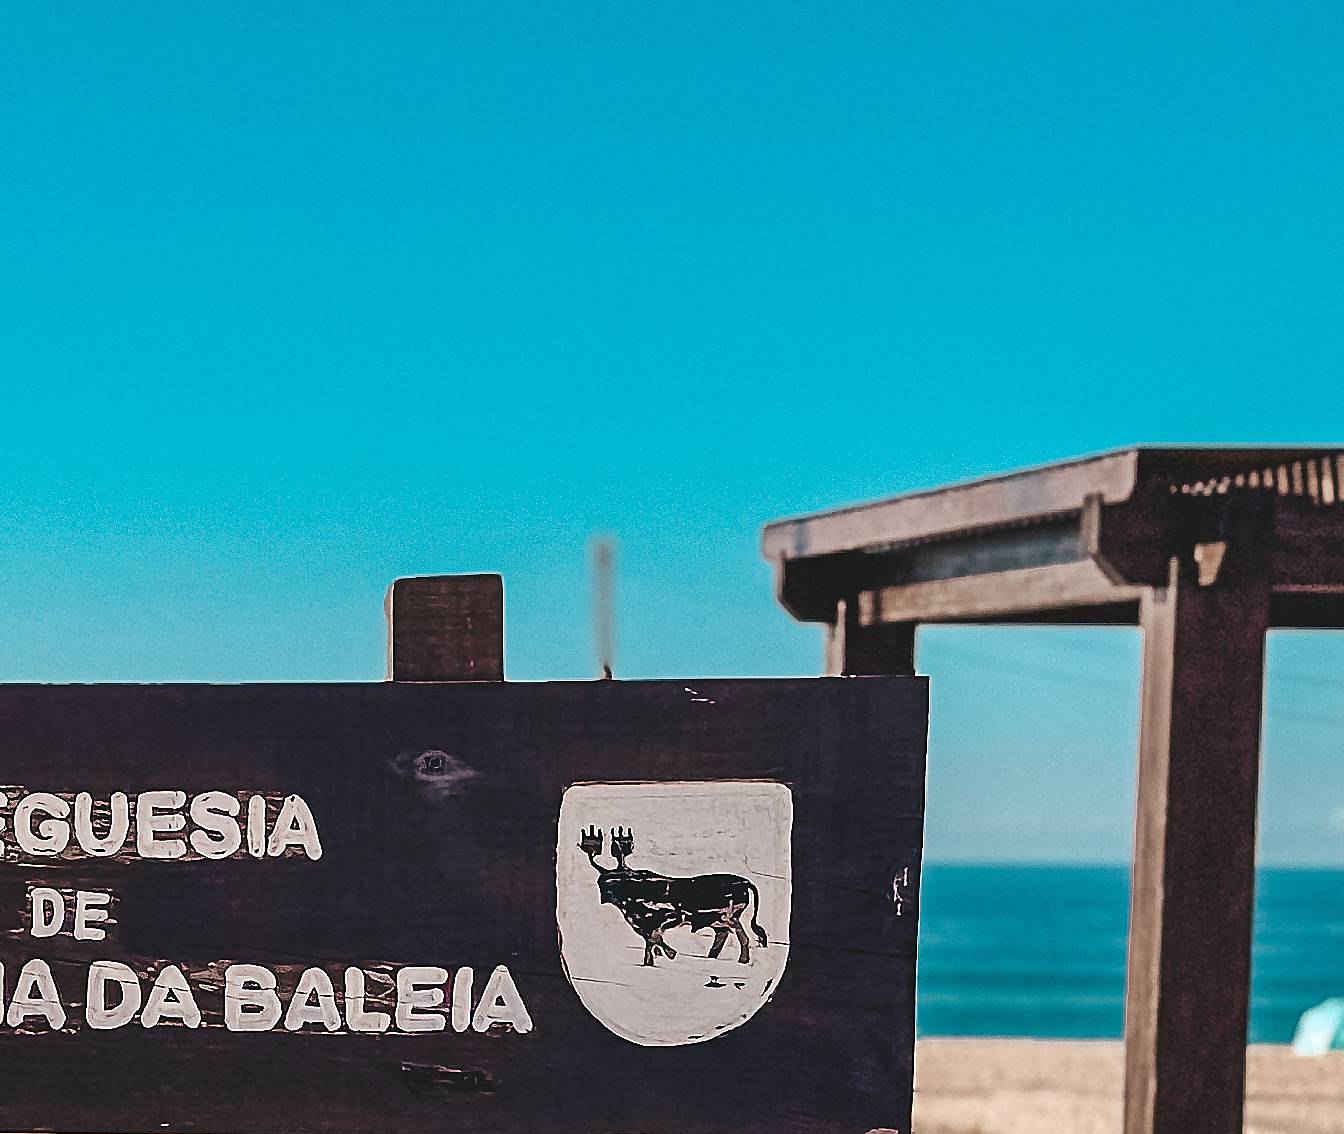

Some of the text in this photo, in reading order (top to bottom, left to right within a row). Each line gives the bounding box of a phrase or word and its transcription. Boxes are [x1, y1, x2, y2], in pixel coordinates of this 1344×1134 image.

[30, 886, 110, 941] DE
[84, 960, 204, 1030] DA
[225, 964, 534, 1034] BALEIA
